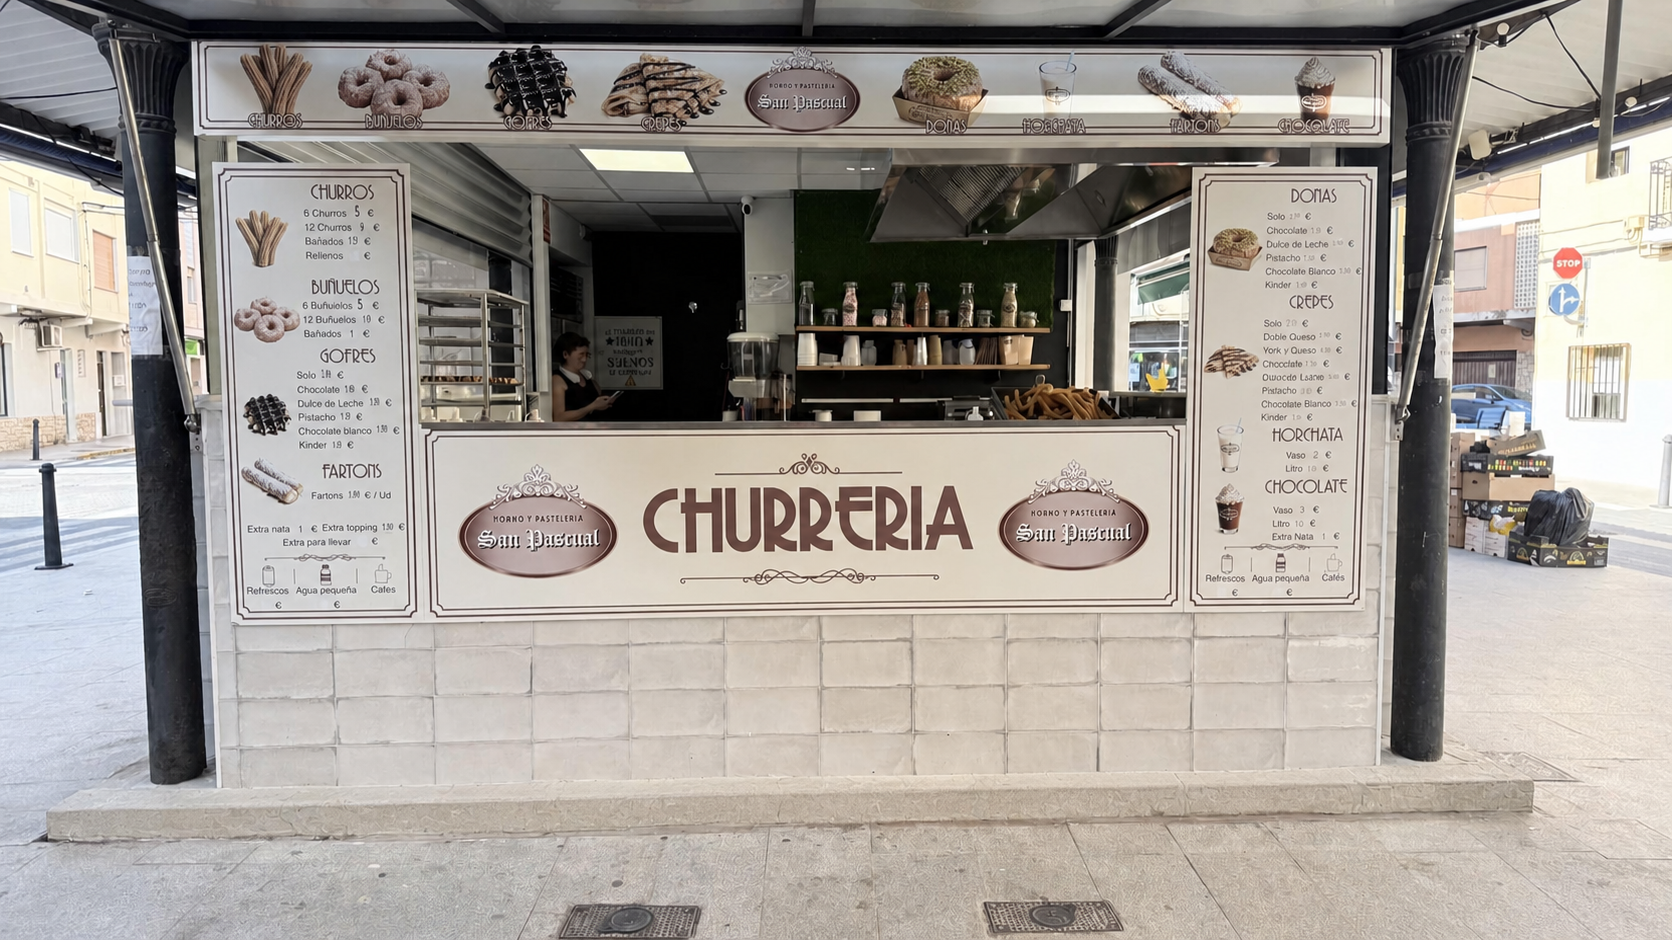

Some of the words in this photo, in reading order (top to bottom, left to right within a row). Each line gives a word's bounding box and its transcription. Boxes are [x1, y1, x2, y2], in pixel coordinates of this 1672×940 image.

[757, 94, 790, 110] San
[792, 95, 847, 114] Pascual
[310, 184, 375, 200] CHURROS
[1291, 188, 1337, 203] DONAS
[303, 208, 310, 217] 6
[312, 209, 347, 218] Churros
[354, 205, 360, 217] 5
[367, 208, 374, 217] €
[1267, 212, 1286, 221] Solo
[1305, 212, 1311, 221] €
[305, 223, 315, 232] 12
[373, 223, 380, 232] €
[1266, 226, 1308, 235] Chocolate
[1326, 226, 1333, 235] €
[305, 236, 344, 246] Bañados
[364, 237, 371, 246] €
[1266, 240, 1290, 249] Dulce
[1291, 240, 1302, 249] de
[1304, 240, 1329, 249] Leche
[1348, 239, 1354, 248] €
[364, 251, 371, 260] €
[1265, 253, 1301, 262] Pistacho
[1320, 253, 1327, 262] €
[1556, 259, 1580, 268] STOP
[1265, 267, 1306, 276] Chocolate
[1308, 267, 1336, 276] Blanco
[1355, 267, 1361, 275] €
[311, 278, 380, 295] BUÑUELOS
[1265, 281, 1291, 289] Kinder
[1311, 281, 1318, 289] €
[302, 301, 309, 310] 6
[357, 298, 363, 310] 5
[372, 301, 379, 310] €
[1289, 295, 1334, 310] CREPES
[303, 315, 313, 324] 12
[378, 315, 385, 324] €
[1264, 319, 1282, 328] Solo
[1302, 319, 1309, 328] €
[303, 329, 342, 338] Bañados
[350, 329, 353, 338] 1
[363, 329, 370, 338] €
[1289, 333, 1316, 341] Queso
[1335, 332, 1342, 340] €
[1263, 346, 1282, 354] York
[1290, 346, 1317, 355] Queso
[1336, 346, 1342, 354] €
[320, 348, 376, 363] GOFRES
[1323, 360, 1329, 368] €
[296, 371, 316, 380] Solo
[337, 371, 344, 380] €
[1344, 373, 1350, 381] €
[297, 385, 340, 394] Chocolate
[361, 384, 368, 394] €
[1316, 386, 1322, 395] €
[297, 399, 323, 408] Dulce
[324, 400, 336, 408] de
[338, 399, 364, 408] Leche
[385, 399, 392, 407] €
[1261, 400, 1302, 408] Chocolate
[1304, 399, 1332, 408] Blanco
[1351, 399, 1357, 407] €
[298, 413, 336, 422] Pistacho
[356, 413, 363, 421] €
[1261, 413, 1288, 421] Kinder
[1306, 413, 1313, 421] €
[298, 426, 342, 436] Chocolate
[343, 427, 372, 435] blanco
[393, 426, 400, 435] €
[1272, 427, 1343, 442] HORCHATA
[299, 441, 327, 449] Kinder
[347, 441, 354, 449] €
[1286, 452, 1306, 460] Vaso
[1313, 450, 1319, 459] 2
[1325, 451, 1331, 459] €
[322, 463, 382, 479] FARTONS
[1285, 464, 1303, 472] Litro
[1322, 464, 1329, 472] €
[1265, 478, 1348, 494] CHOCOLATE
[311, 491, 344, 500] Fartons
[364, 491, 371, 499] €
[379, 491, 391, 499] Ud
[1070, 509, 1116, 517] PASTELERIA
[1273, 506, 1293, 514] Vaso
[1300, 505, 1305, 514] 3
[1313, 505, 1319, 513] €
[535, 514, 583, 523] PASTELERIA
[643, 486, 972, 553] CHURRERIA
[247, 525, 269, 533] Extra
[299, 525, 302, 533] 1
[311, 525, 317, 533] €
[322, 523, 344, 532] Extra
[346, 524, 378, 533] topping
[398, 523, 405, 531] €
[1295, 520, 1304, 528] 10
[1310, 519, 1316, 527] €
[1016, 524, 1056, 542] San
[1060, 523, 1132, 546] Pascual
[1272, 532, 1292, 541] Extra
[1294, 533, 1314, 541] Nata
[1333, 532, 1340, 540] €
[283, 538, 305, 546] Extra
[307, 539, 326, 548] para
[371, 537, 378, 545] €
[477, 529, 520, 550] San
[526, 528, 601, 552] Pascual
[1205, 574, 1246, 583] Refrescos
[1251, 574, 1273, 584] Agua
[1275, 574, 1310, 584] pequeña
[246, 586, 289, 595] Refrescos
[295, 586, 318, 597] Agua
[320, 586, 357, 596] pequeña
[1232, 588, 1238, 597] €
[1286, 588, 1293, 596] €
[275, 601, 282, 609] €
[333, 600, 340, 609] €
